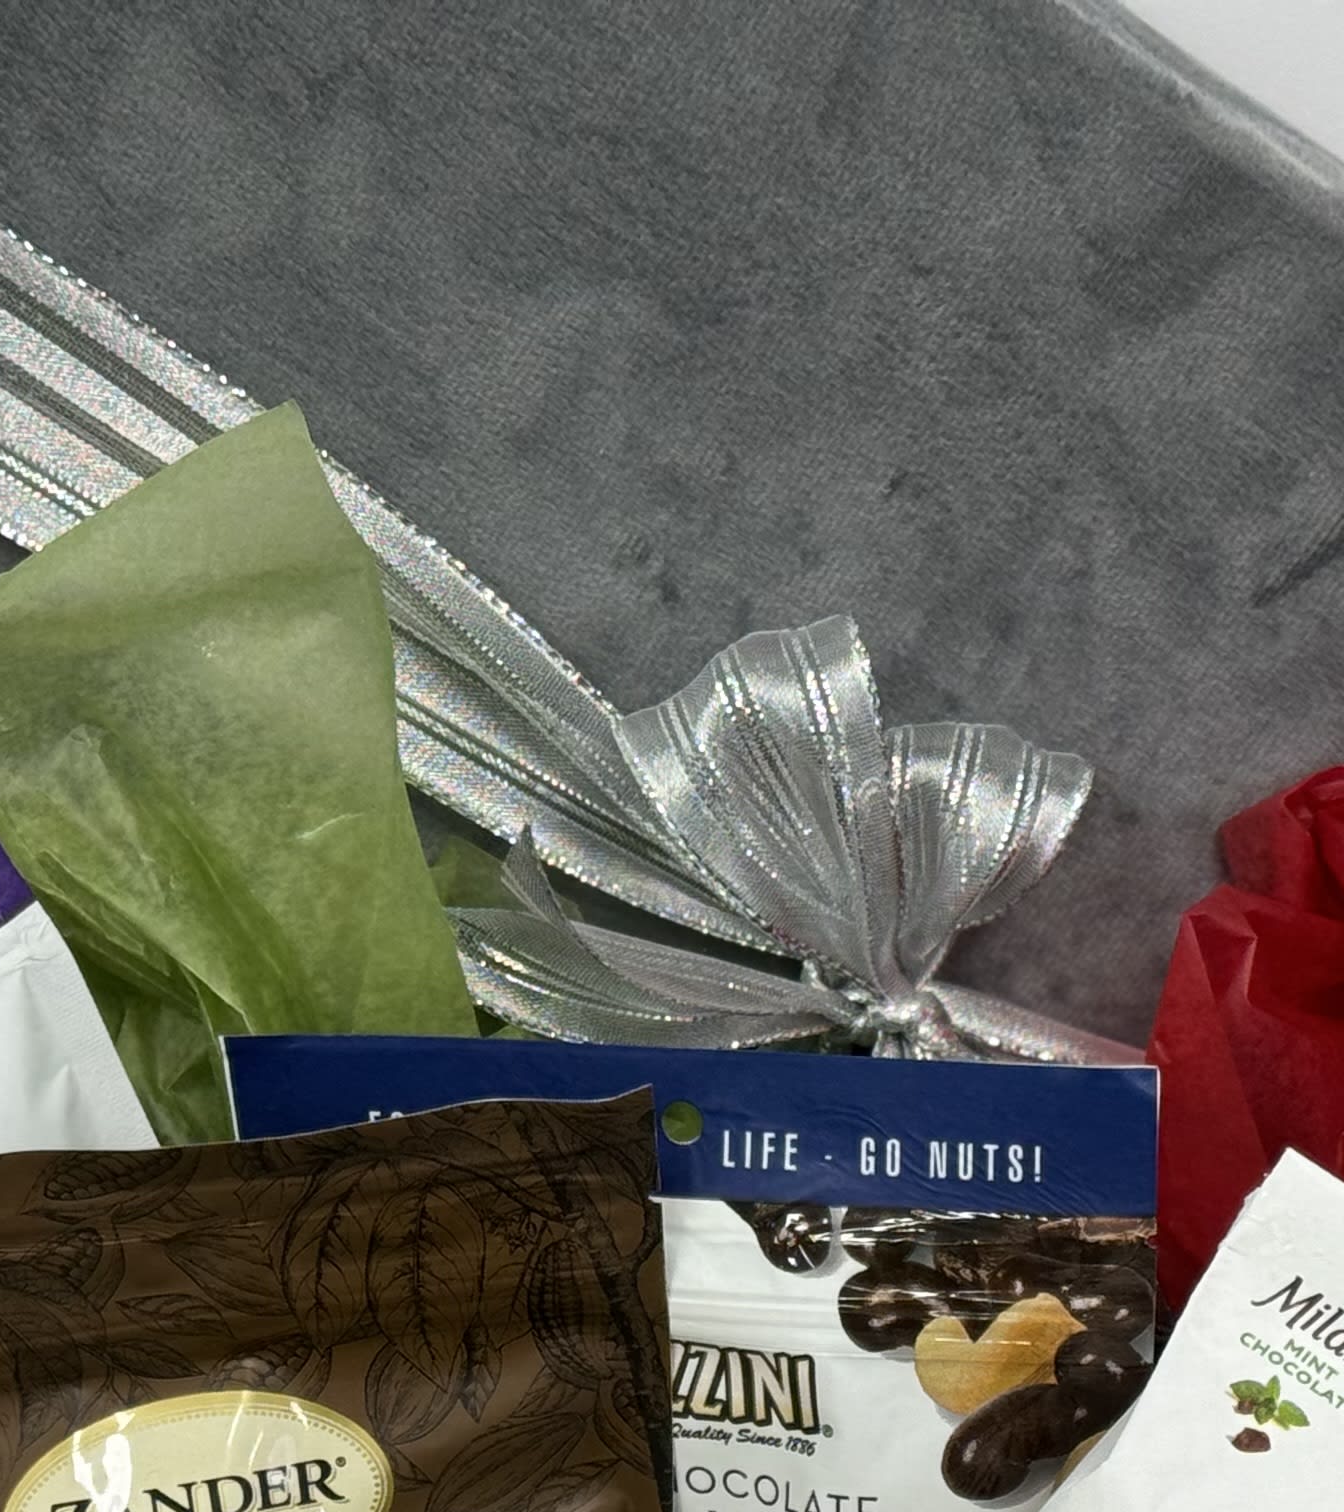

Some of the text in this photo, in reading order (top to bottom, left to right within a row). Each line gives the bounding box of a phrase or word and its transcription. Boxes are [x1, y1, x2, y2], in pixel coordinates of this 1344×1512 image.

[722, 1129, 798, 1171] LIFE
[860, 1136, 901, 1177] GO
[929, 1141, 1042, 1183] NUTS!
[1283, 1338, 1340, 1381] MINT
[670, 1340, 822, 1436] ZZINI
[671, 1422, 816, 1457] Quality Since 1886
